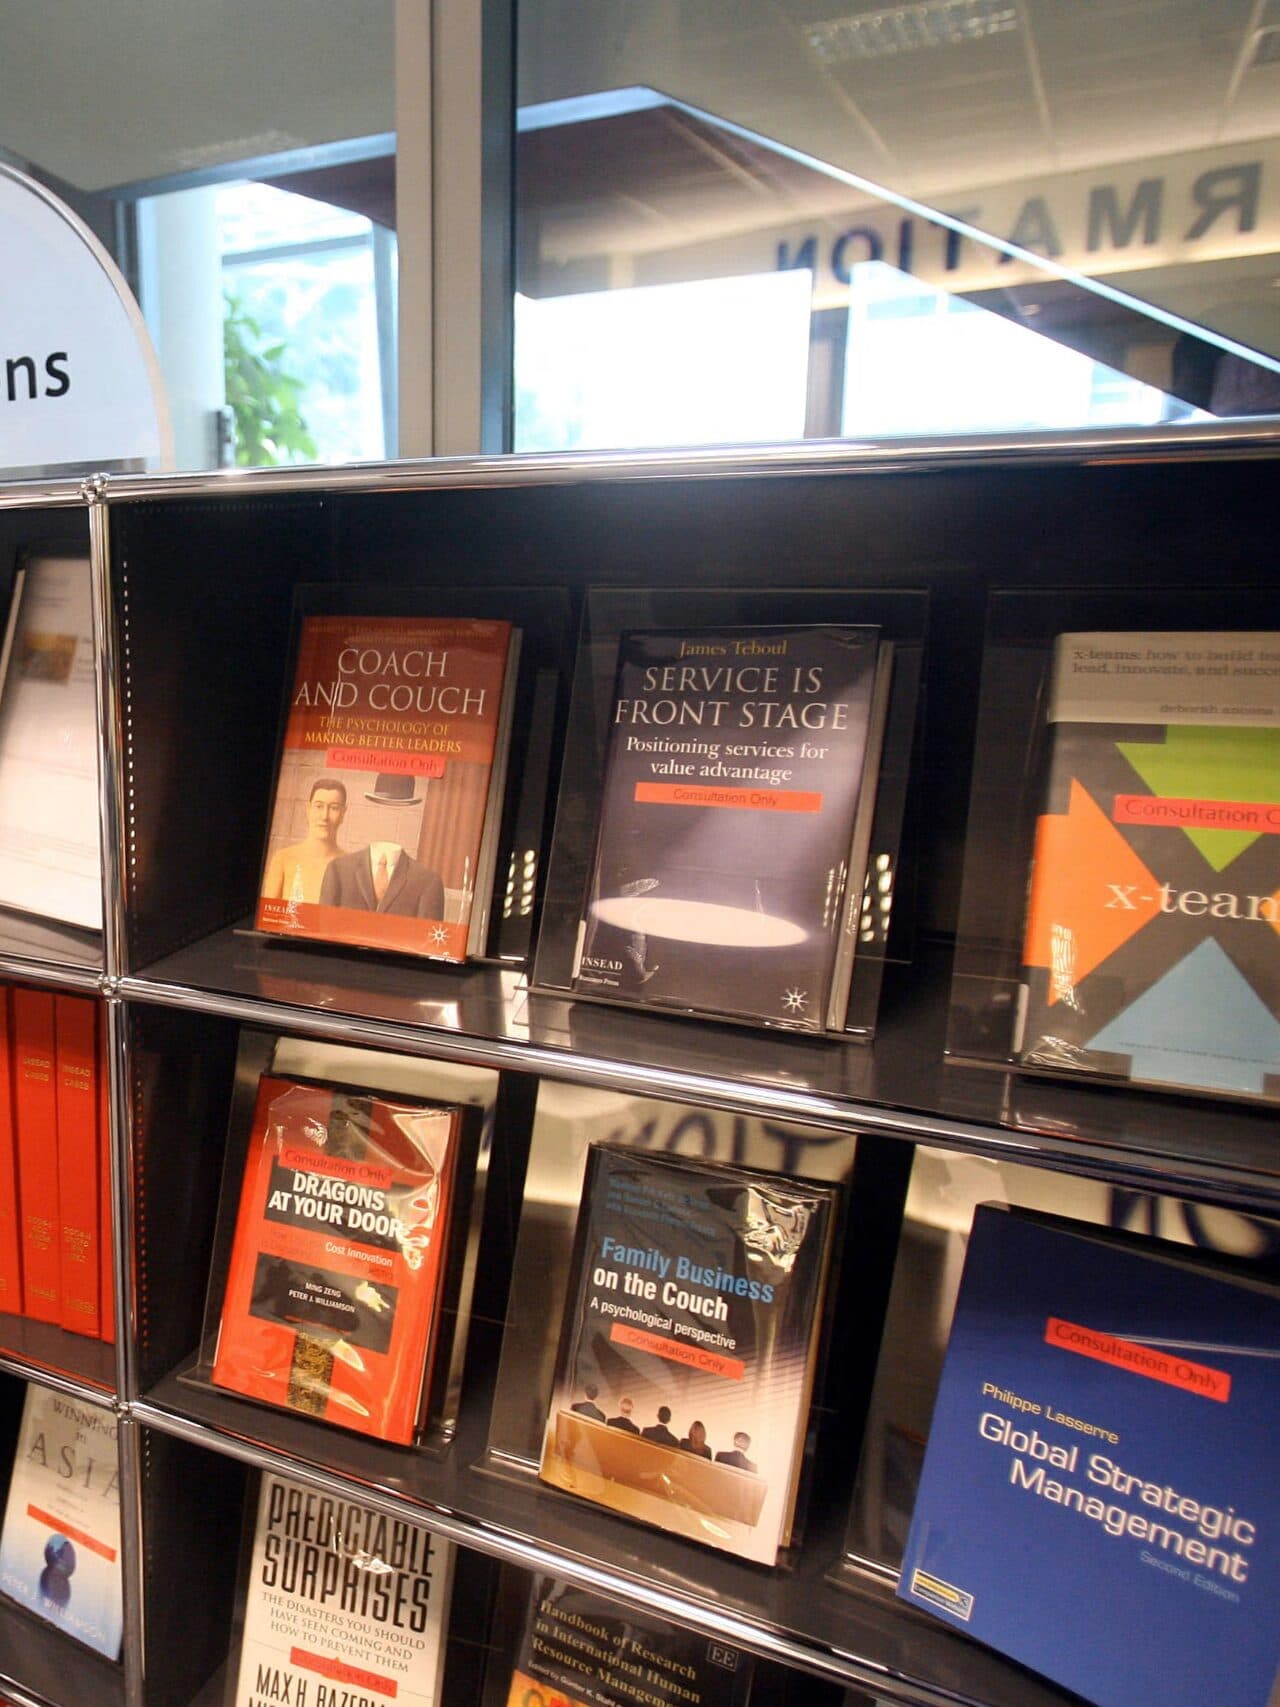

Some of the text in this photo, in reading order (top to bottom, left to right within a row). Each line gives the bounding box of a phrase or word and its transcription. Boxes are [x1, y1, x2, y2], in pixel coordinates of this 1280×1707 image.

[338, 648, 448, 677] COACH
[680, 640, 787, 657] James Teboul
[295, 681, 486, 716] AND COUCH
[643, 666, 823, 693] SERVICE IS
[320, 716, 449, 736] THE PSYCHOLOGY OF
[615, 699, 849, 730] FRONT STAGE
[305, 732, 462, 753] MAKING BETTER LEADERS
[332, 751, 441, 774] Consultation Only
[627, 737, 829, 760] Positioning services for
[651, 759, 793, 785] value advantage
[673, 788, 778, 807] Consultation Only
[1125, 800, 1258, 824] Consultation
[582, 957, 623, 971] INSEAD
[285, 1150, 355, 1178] Consultation
[293, 1171, 385, 1211] DRAGONS
[268, 1191, 406, 1239] AT YOUR DOOR
[325, 1241, 393, 1267] Cost Innovation
[601, 1237, 774, 1303] Family Business
[289, 1289, 308, 1301] PETER
[315, 1297, 356, 1313] WILLIAMSON
[305, 1282, 341, 1298] MING ZENG
[593, 1267, 728, 1321] on the Couch
[590, 1297, 736, 1350] A psychological perspective
[627, 1330, 724, 1372] Consultation Only
[1055, 1324, 1220, 1392] Consultation Only
[982, 1382, 1119, 1444] Philippe Lasserre
[979, 1413, 1256, 1547] Global Strategic
[268, 1484, 434, 1577] PREDICTABLE
[1010, 1458, 1249, 1583] Management
[262, 1535, 433, 1633] SURPRISES
[1141, 1551, 1241, 1603] Second Edition
[261, 1591, 425, 1651] THE DISASTERS YOU SHOULD
[270, 1608, 413, 1662] HAVE SEEN COMING AND
[540, 1600, 697, 1681] Handbook of Research
[271, 1621, 409, 1673] HOW TO PREVENT THEM
[532, 1634, 594, 1675] Resource
[536, 1618, 701, 1705] in International Human
[711, 1646, 734, 1668] EE
[256, 1664, 293, 1706] MAX
